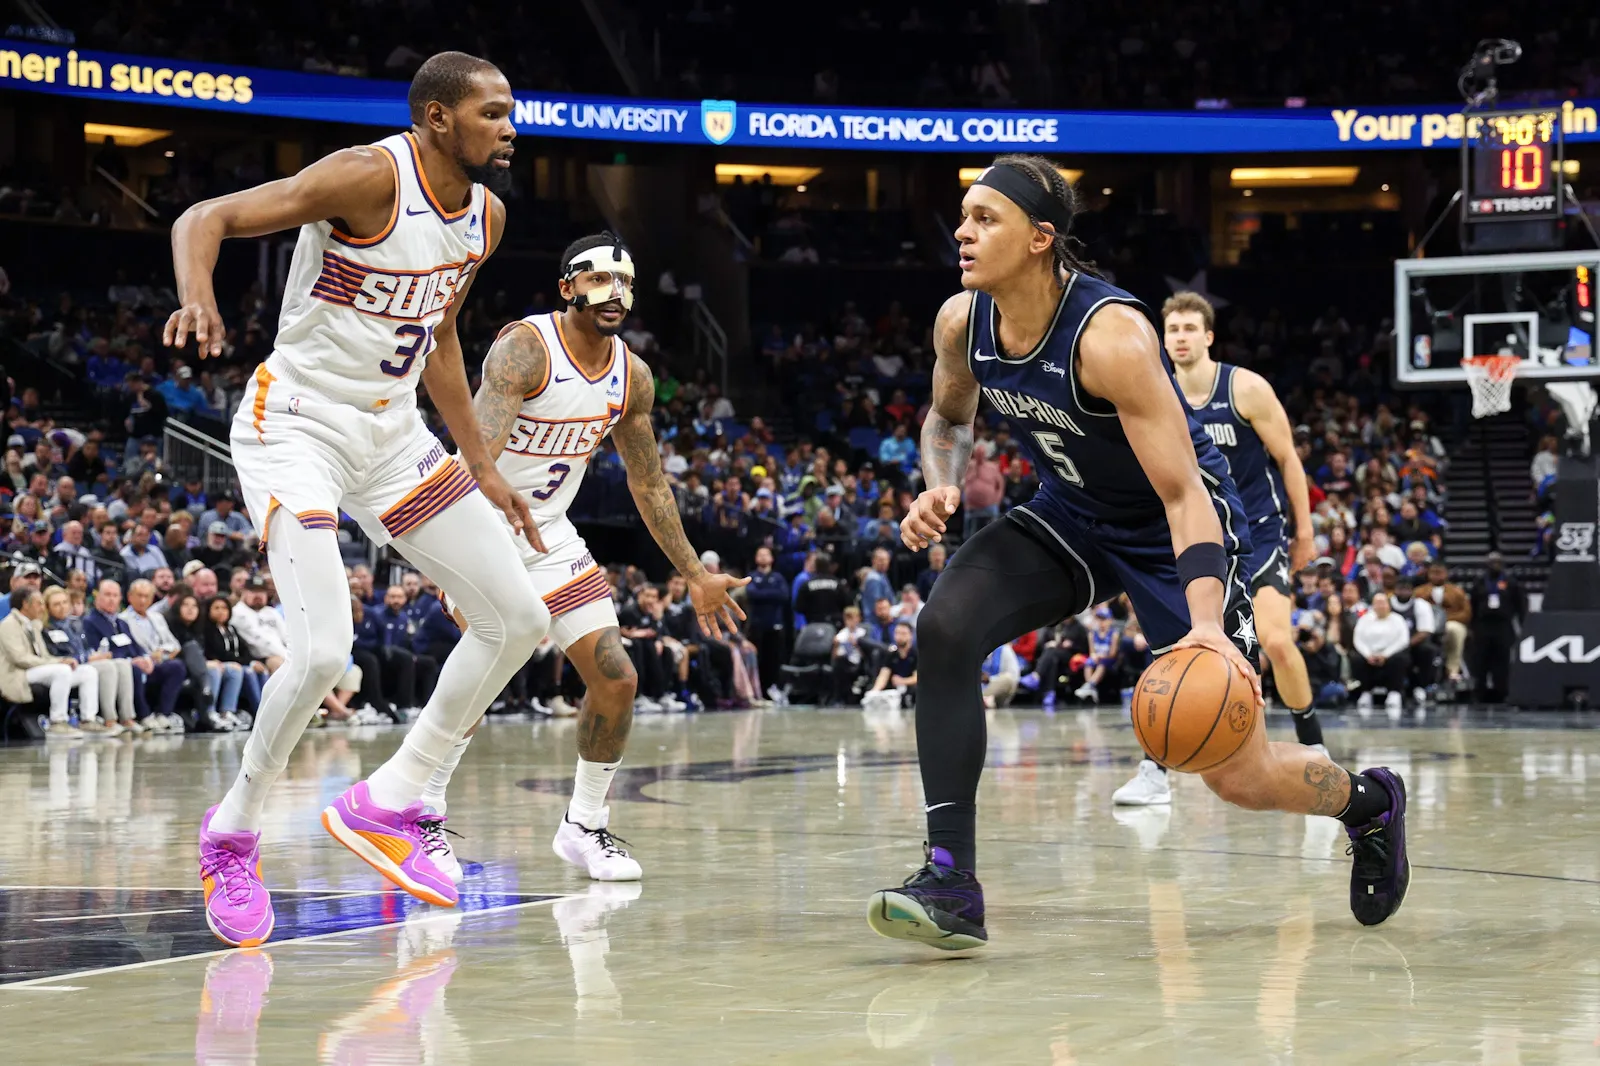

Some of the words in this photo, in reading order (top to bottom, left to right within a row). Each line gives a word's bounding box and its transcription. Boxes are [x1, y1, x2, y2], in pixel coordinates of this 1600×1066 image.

[67, 50, 103, 89] in
[110, 63, 253, 104] success
[514, 100, 568, 127] NUC
[571, 104, 688, 133] UNIVERSITY
[749, 112, 838, 139] FLORIDA
[840, 115, 959, 142] TECHNICAL
[962, 118, 1059, 142] COLLEGE
[1332, 109, 1416, 141] Your
[1562, 101, 1597, 134] in
[1501, 145, 1543, 191] 10
[1493, 196, 1556, 212] TISSOT
[1039, 360, 1065, 378] Disney
[505, 418, 604, 455] SUNS
[417, 441, 445, 478] PHOE
[1030, 431, 1084, 488] 5
[532, 463, 570, 501] 3
